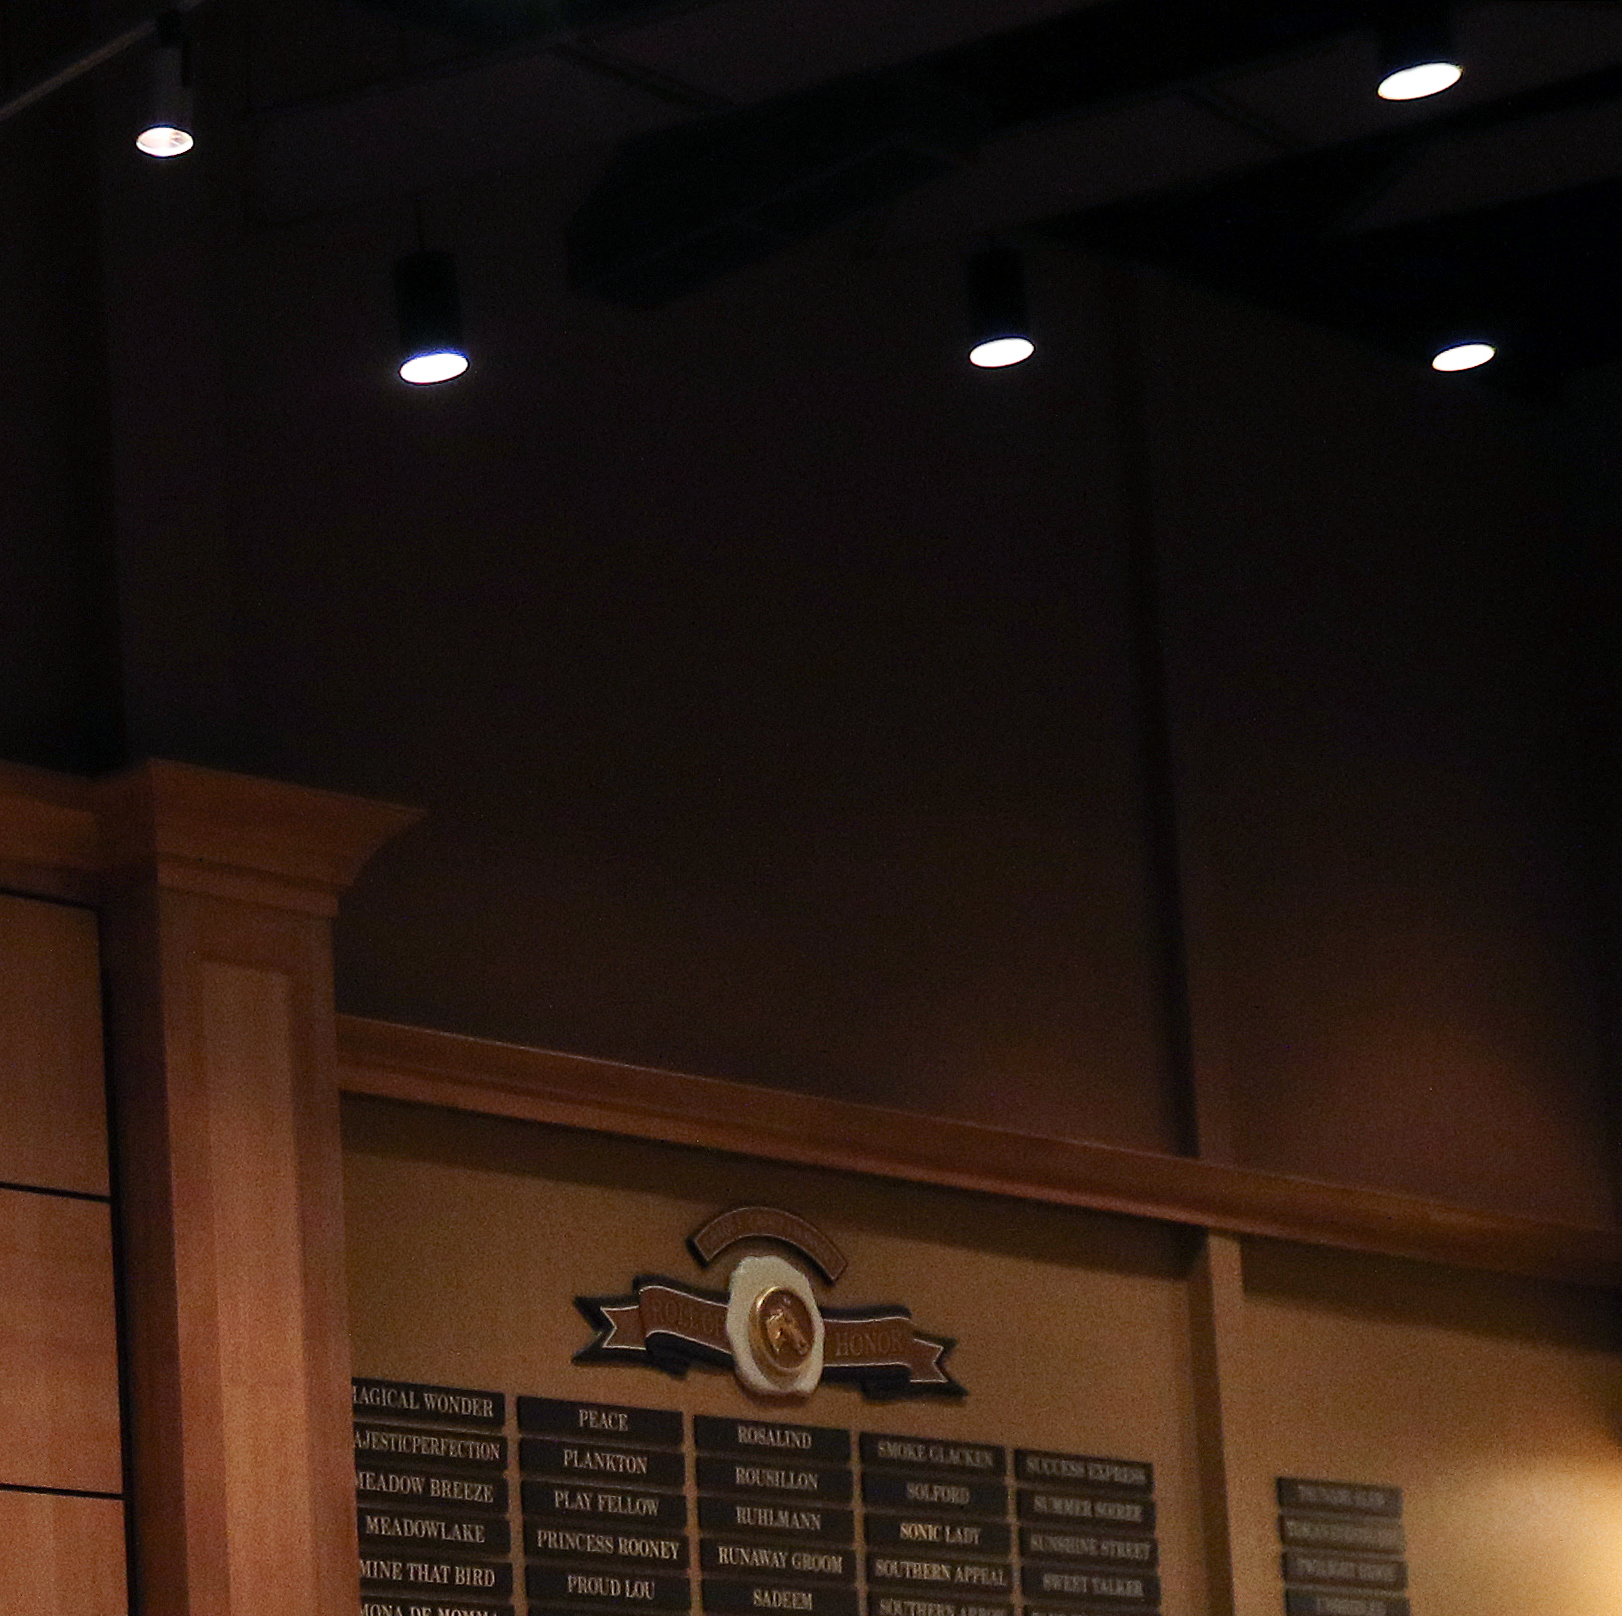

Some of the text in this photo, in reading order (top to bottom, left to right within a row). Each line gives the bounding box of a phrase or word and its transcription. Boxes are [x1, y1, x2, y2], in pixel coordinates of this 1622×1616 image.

[652, 1298, 698, 1330] ROLL
[835, 1329, 903, 1356] HONOR
[424, 1392, 494, 1417] WONDER
[579, 1409, 628, 1432] PEACE
[356, 1431, 501, 1460] AJESTICPERFECTION
[738, 1426, 812, 1449] ROSALIND
[563, 1449, 648, 1474] PLANKTON
[878, 1441, 925, 1461] SMOKE
[430, 1479, 494, 1503] BREEZE
[736, 1467, 818, 1490] ROUSILLON
[554, 1490, 658, 1516] PLAY FELLOW
[907, 1484, 970, 1505] SOLFORD
[365, 1515, 485, 1543] MEADOWLAKE
[737, 1506, 821, 1530] RUHLMANN
[537, 1530, 681, 1560] PRINCESS ROONEY
[900, 1522, 981, 1545] SONIC LADY
[718, 1546, 842, 1574] RUNAWAY GROOM
[874, 1559, 1004, 1586] SOUTHERN APPEAL
[360, 1560, 496, 1587] MINE THAT BIRD
[568, 1575, 655, 1600] PROUD LOU
[753, 1589, 812, 1610] SADEEM
